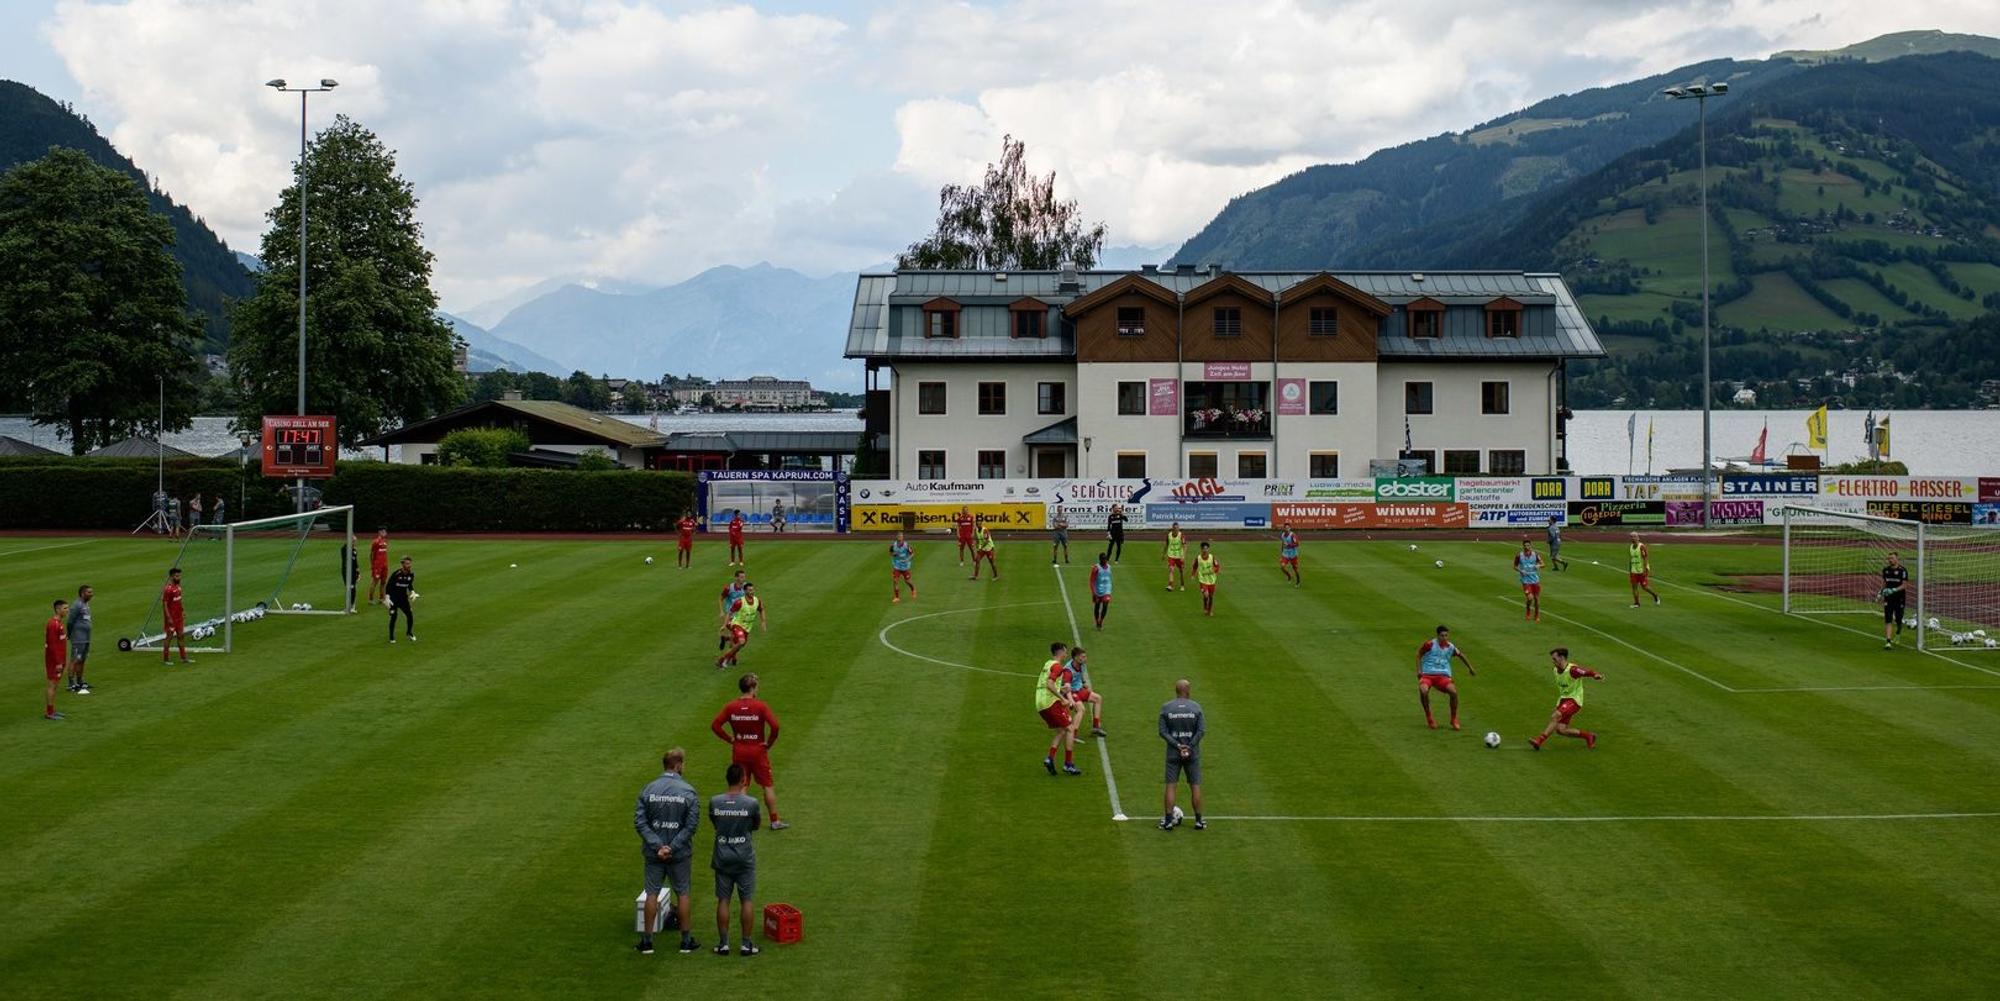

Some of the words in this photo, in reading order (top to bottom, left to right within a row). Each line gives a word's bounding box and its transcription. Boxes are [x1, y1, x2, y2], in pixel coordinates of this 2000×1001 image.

[283, 430, 319, 444] 17:47
[905, 483, 929, 491] Auto
[930, 482, 984, 491] Kaufmann
[1172, 477, 1225, 503] VOGL
[1378, 481, 1451, 496] ebster
[1624, 484, 1660, 499] TAP
[1724, 482, 1817, 492] STAINER
[1839, 480, 1897, 496] ELEKTRO
[1910, 480, 1962, 497] RASSER
[1869, 503, 1918, 512] DIESEL
[976, 512, 1010, 523] Bank
[1479, 511, 1506, 520] ATP
[650, 794, 685, 803] Barmenia
